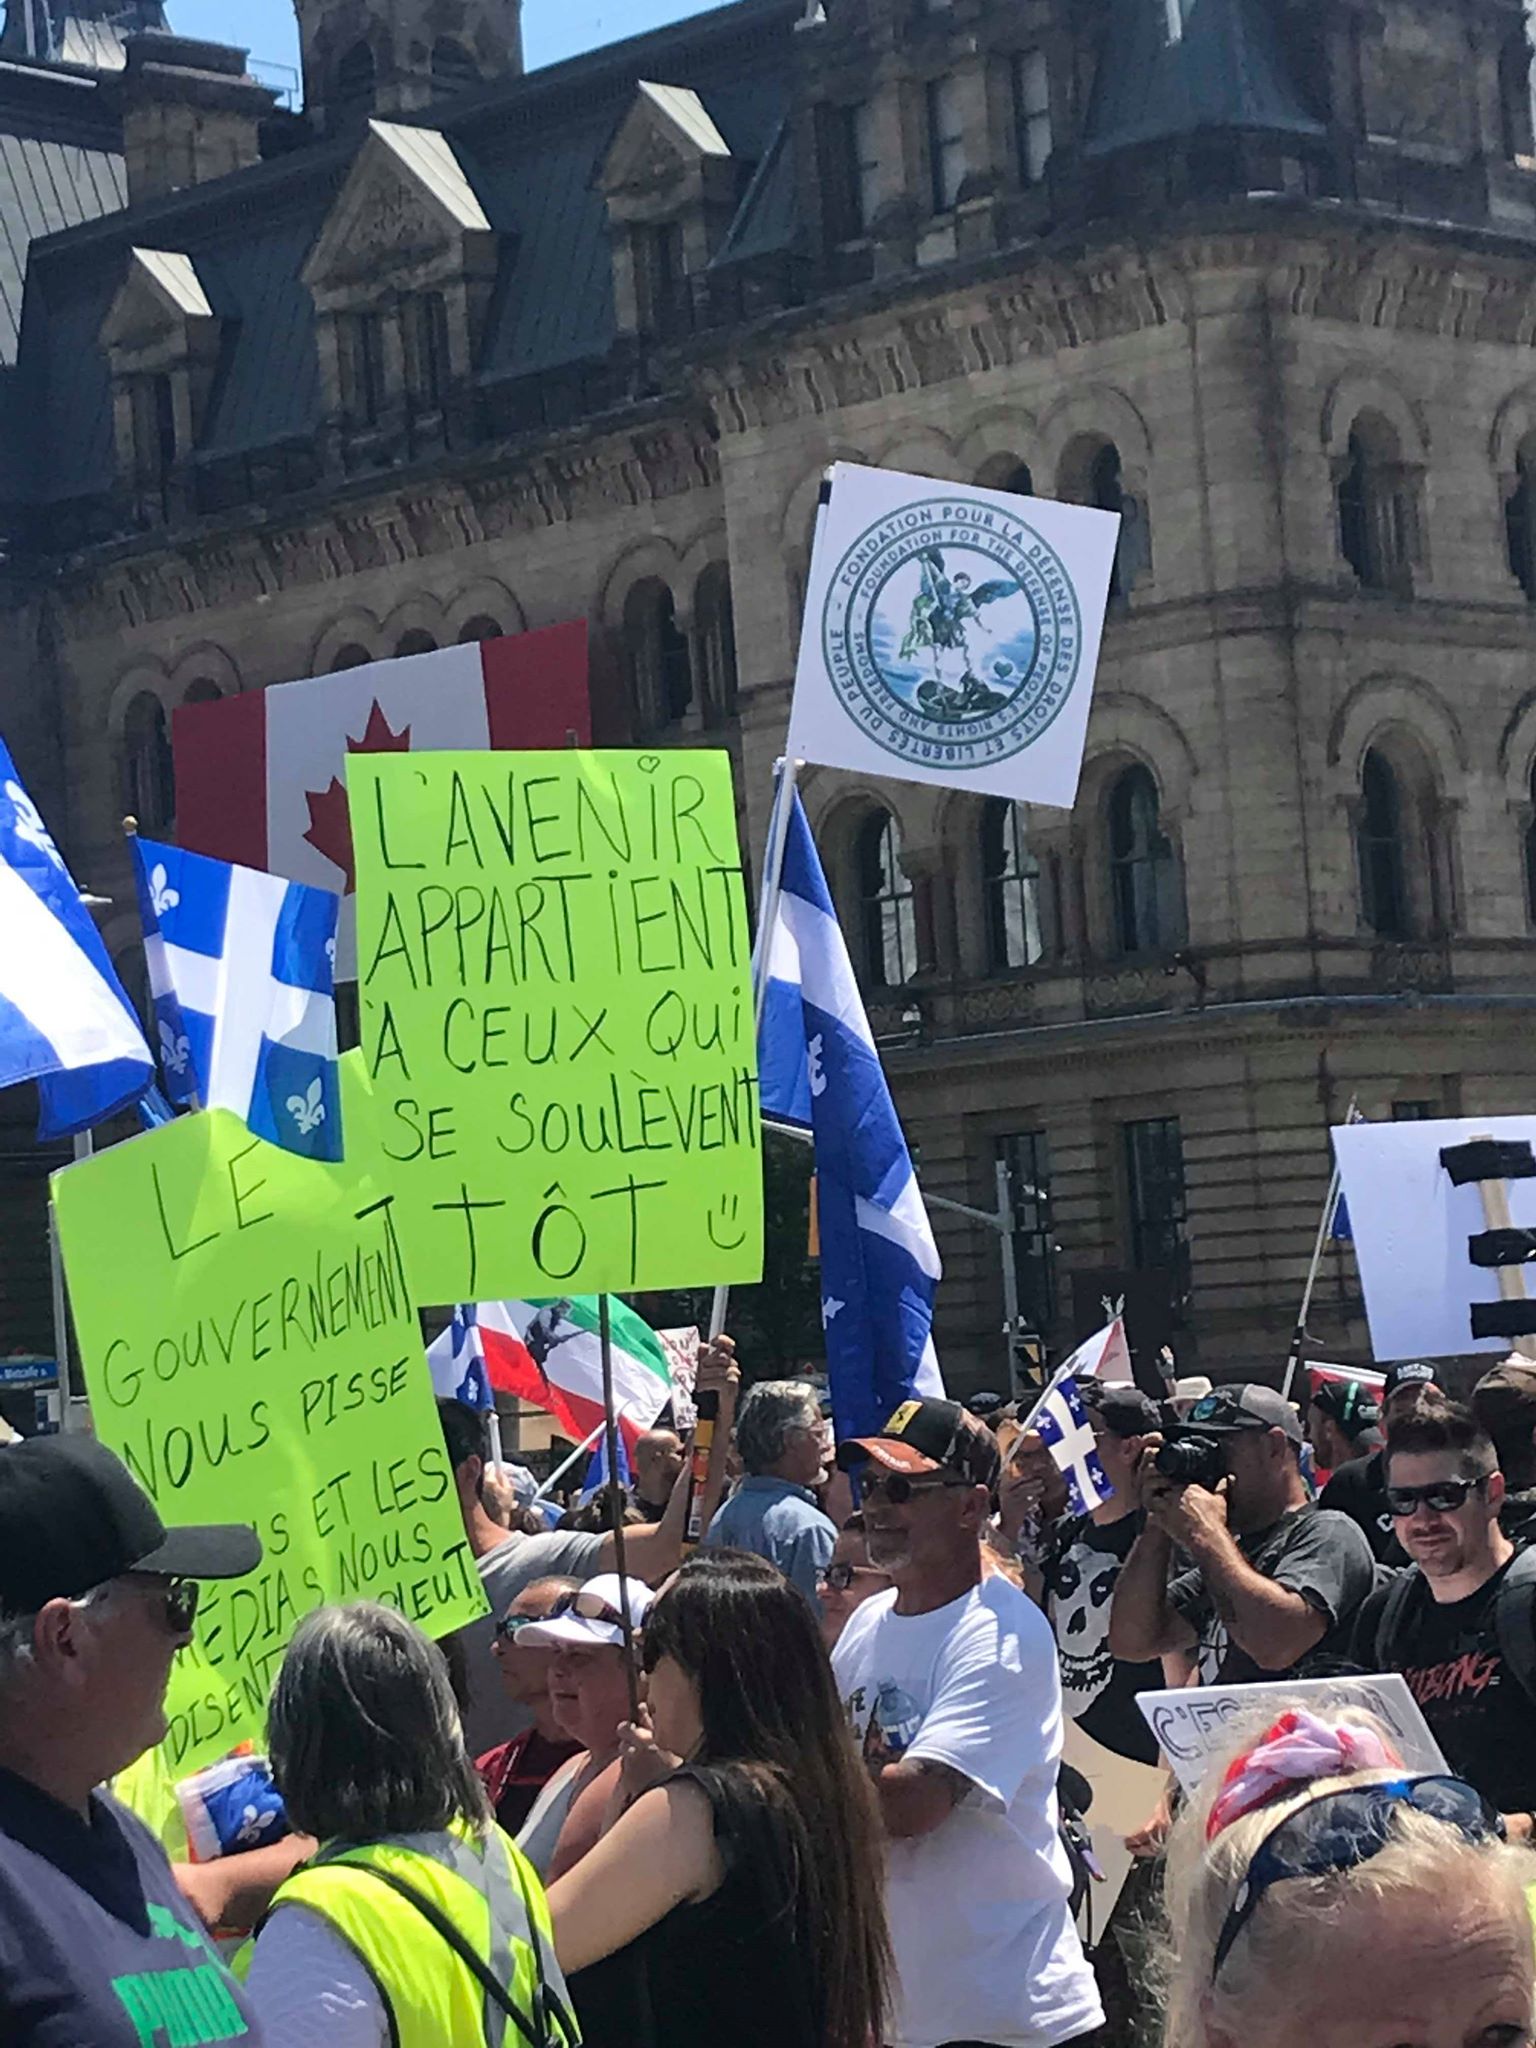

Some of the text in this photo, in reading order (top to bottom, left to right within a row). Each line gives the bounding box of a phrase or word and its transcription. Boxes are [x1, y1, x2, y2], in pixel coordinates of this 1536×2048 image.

[861, 529, 942, 598] FOUNDATION
[950, 529, 981, 542] FOR
[988, 538, 1013, 560] THE
[1016, 563, 1051, 624] DEFENSE
[831, 507, 1073, 761] FONDATION POUR LA DÉFENSE DES DROITS ET LIBERTÉS DU PEUPLE
[854, 632, 895, 711] FREEDOMS
[1039, 635, 1052, 655] OF
[898, 709, 930, 730] AND
[937, 718, 993, 738] RIGHTS
[364, 866, 743, 990] APPARTIENT
[443, 997, 615, 1074] CEUX
[382, 1067, 759, 1162] SE SOULÈVENT
[151, 1137, 276, 1261] LE
[432, 1172, 668, 1297] TÔT
[102, 1194, 412, 1409] GOUVERNEMENT
[123, 1356, 411, 1502] NOUS PISSE
[312, 1470, 354, 1538] ET
[370, 1446, 449, 1517] LES
[339, 1522, 433, 1596] NOUS
